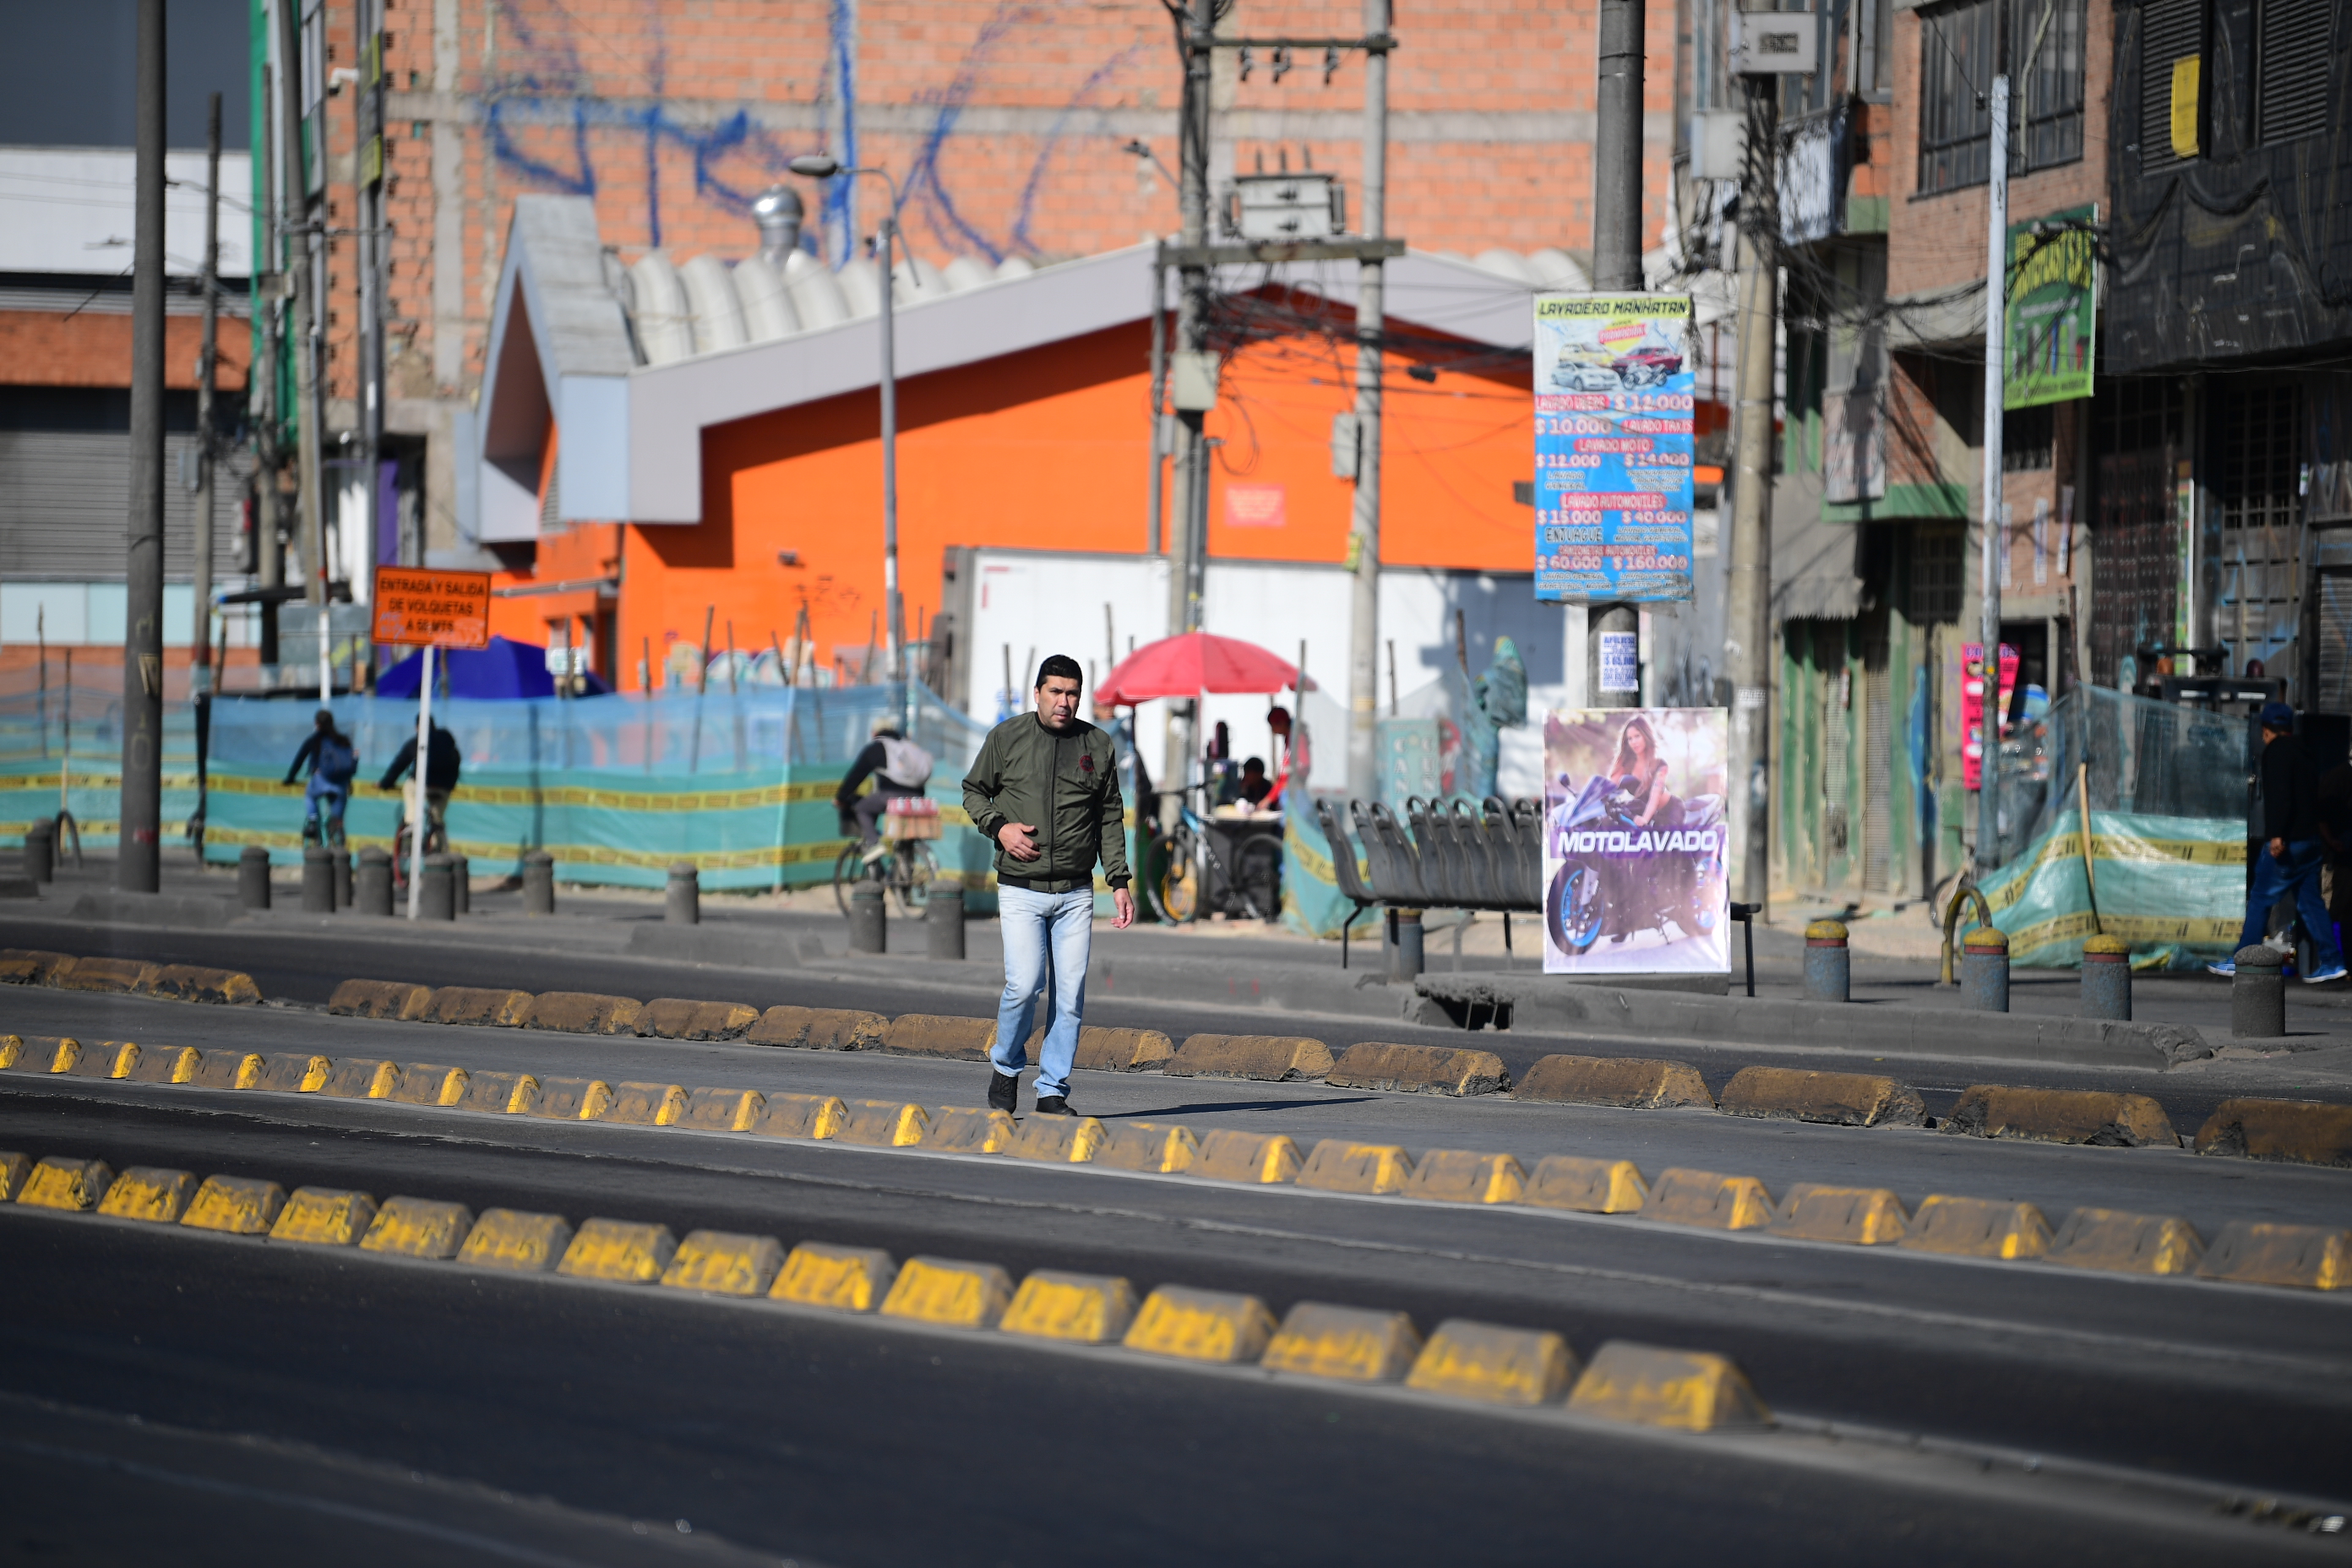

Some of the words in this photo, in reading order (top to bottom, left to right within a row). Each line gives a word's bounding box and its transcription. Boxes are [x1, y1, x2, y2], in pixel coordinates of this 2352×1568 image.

[1539, 302, 1609, 315] LAVADERO
[1613, 301, 1688, 314] MANHATAN
[1536, 395, 1573, 410] LAVADO
[1614, 394, 1626, 411] $
[1631, 394, 1694, 411] 12.000
[1535, 417, 1546, 434] $
[1549, 417, 1613, 434] 10.000
[1625, 420, 1662, 433] LAVADO
[1580, 438, 1620, 452] LAVADO
[1622, 438, 1651, 452] MOTO
[1536, 454, 1545, 468] $
[1549, 454, 1602, 468] 12.000
[1625, 453, 1634, 467] $
[1563, 494, 1598, 509] LAVADO
[1600, 494, 1663, 509] AUTOMOVILES
[1537, 509, 1548, 525] $
[1549, 509, 1603, 525] 15.000
[1622, 510, 1632, 525] $
[1634, 510, 1688, 524] 40.000
[1538, 555, 1548, 570] $
[1550, 555, 1602, 569] 60.000
[1614, 555, 1623, 570] $
[1625, 555, 1688, 570] 160.000
[380, 577, 433, 593] ENTRADA
[435, 580, 443, 593] Y
[445, 581, 484, 597] SALIDA
[389, 598, 404, 612] DE
[407, 599, 473, 616] VOLQUETAS
[406, 618, 414, 631] A
[432, 620, 454, 633] MTS
[1559, 830, 1718, 853] MOTOLAVADO
